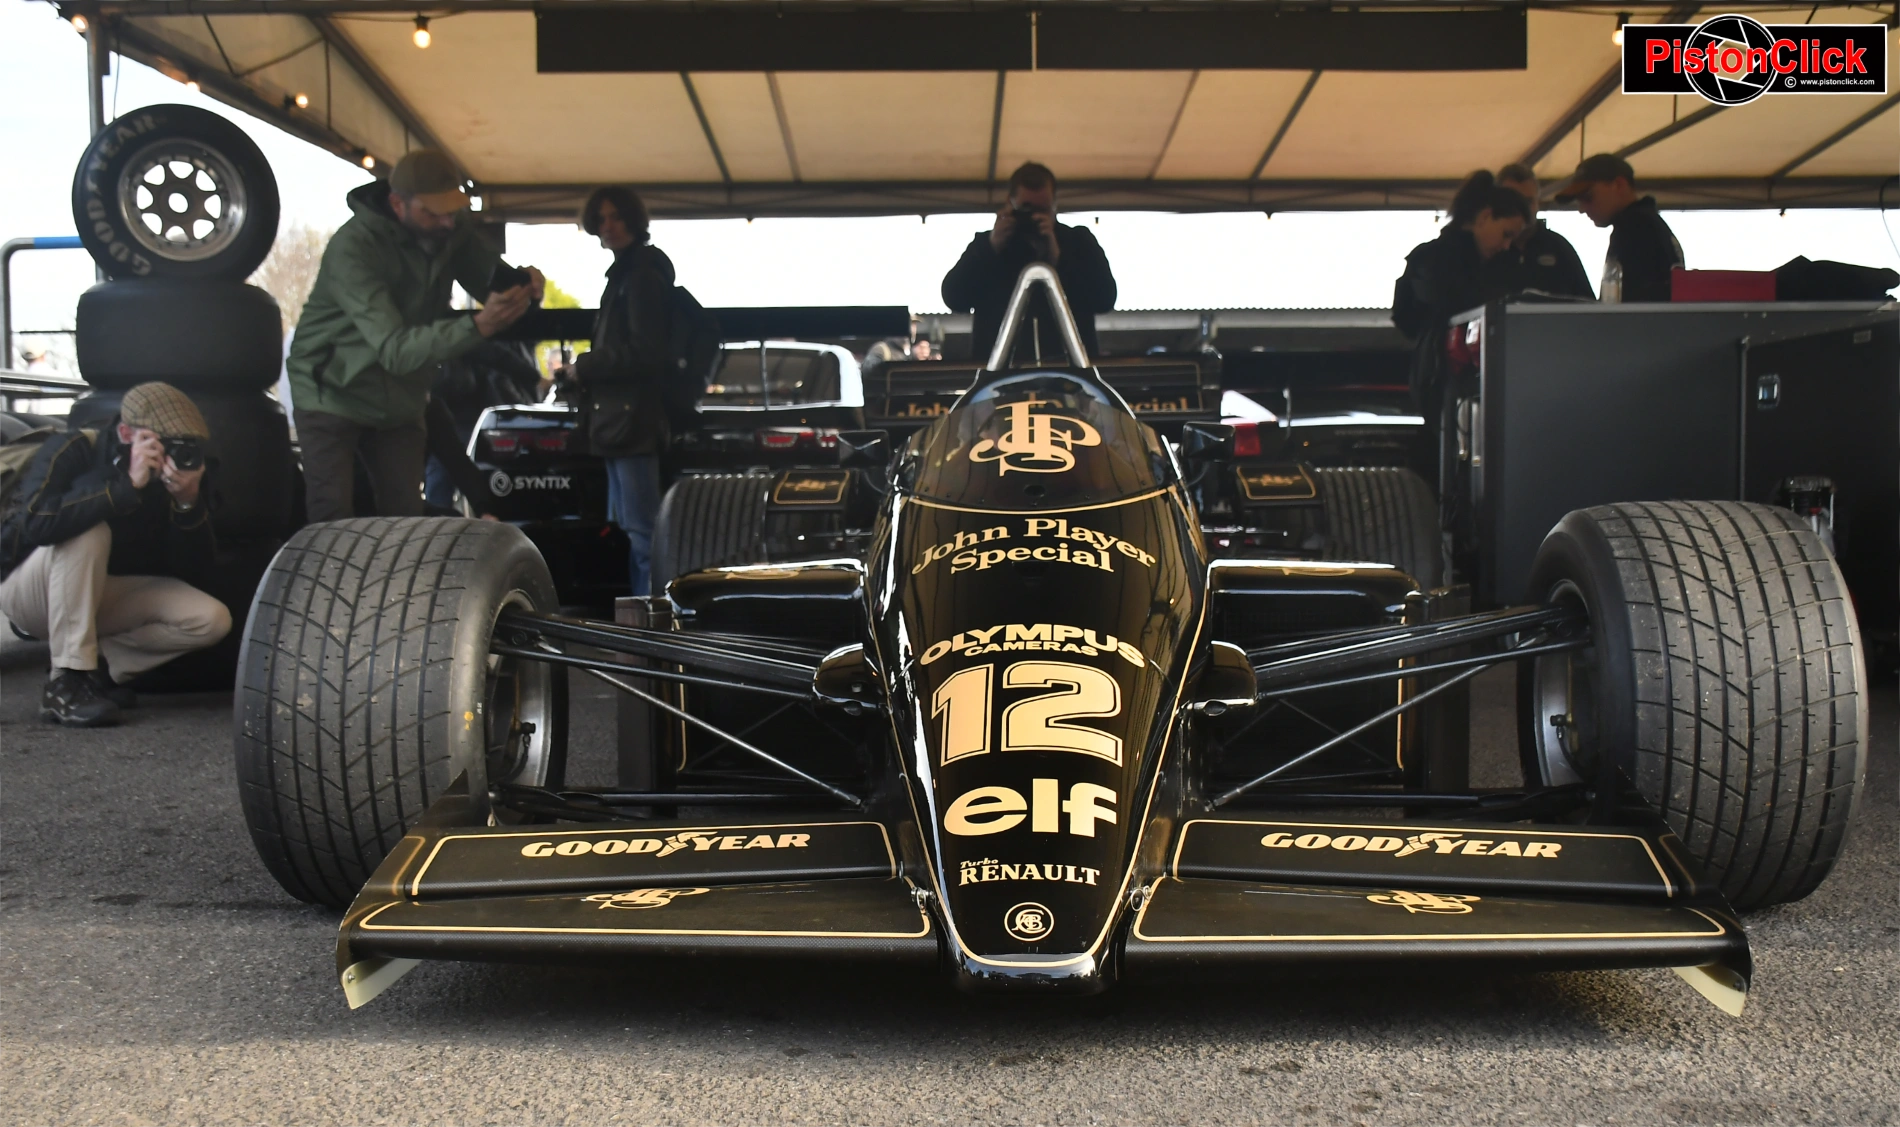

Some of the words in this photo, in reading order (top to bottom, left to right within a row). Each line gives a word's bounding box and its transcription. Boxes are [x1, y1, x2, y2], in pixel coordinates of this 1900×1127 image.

[897, 403, 949, 418] Joh
[1129, 396, 1188, 412] cial
[513, 476, 572, 490] SYNTIX
[911, 525, 1011, 575] John
[1023, 518, 1157, 568] Player
[950, 542, 1115, 575] Special
[919, 623, 1146, 669] OLYMPUS
[963, 641, 1099, 658] CAMERAS
[930, 660, 1123, 768] 12
[943, 778, 1117, 838] elf
[958, 863, 1100, 887] RENAULT
[959, 857, 999, 868] Turbo
